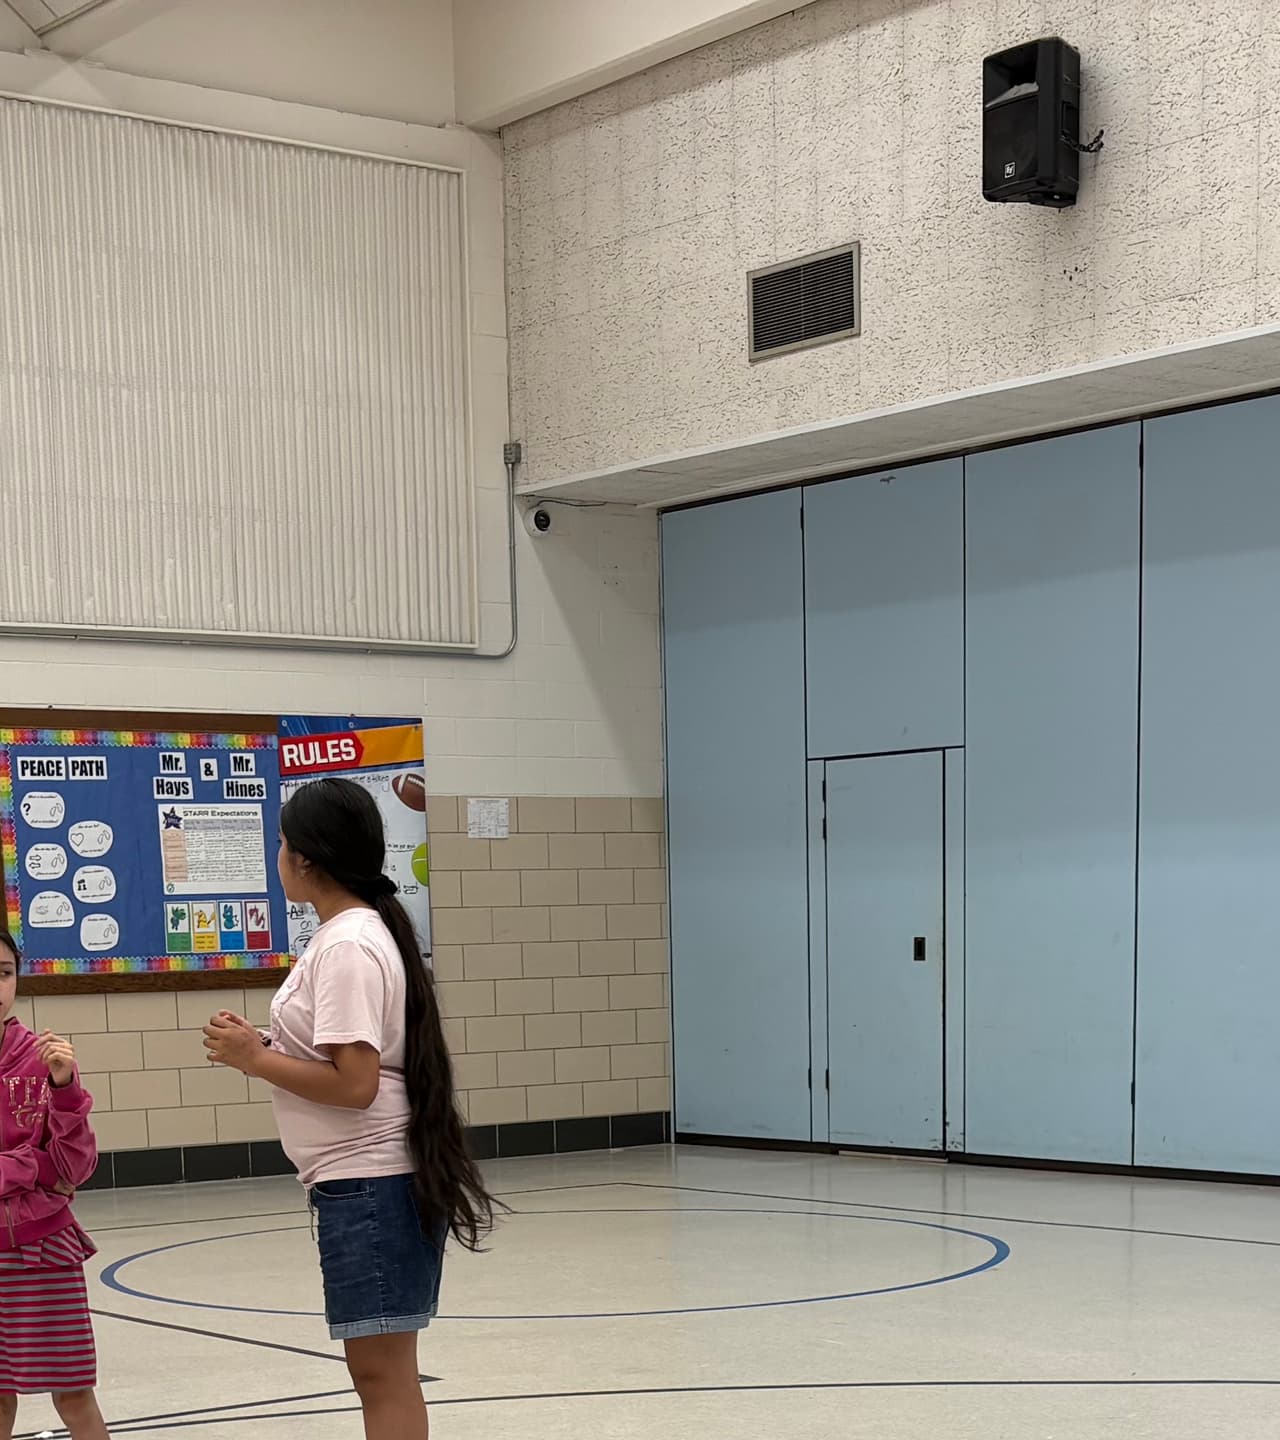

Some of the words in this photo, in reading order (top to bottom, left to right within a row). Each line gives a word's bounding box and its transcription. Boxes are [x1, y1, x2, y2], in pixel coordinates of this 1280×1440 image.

[282, 738, 357, 768] RULES
[20, 760, 63, 777] PEACE
[71, 760, 105, 777] PATH
[162, 754, 182, 771] Mr.
[204, 762, 214, 776] &
[232, 756, 253, 772] Mr.
[155, 779, 190, 796] Hays
[226, 781, 264, 797] Hines
[210, 810, 259, 818] Expectations
